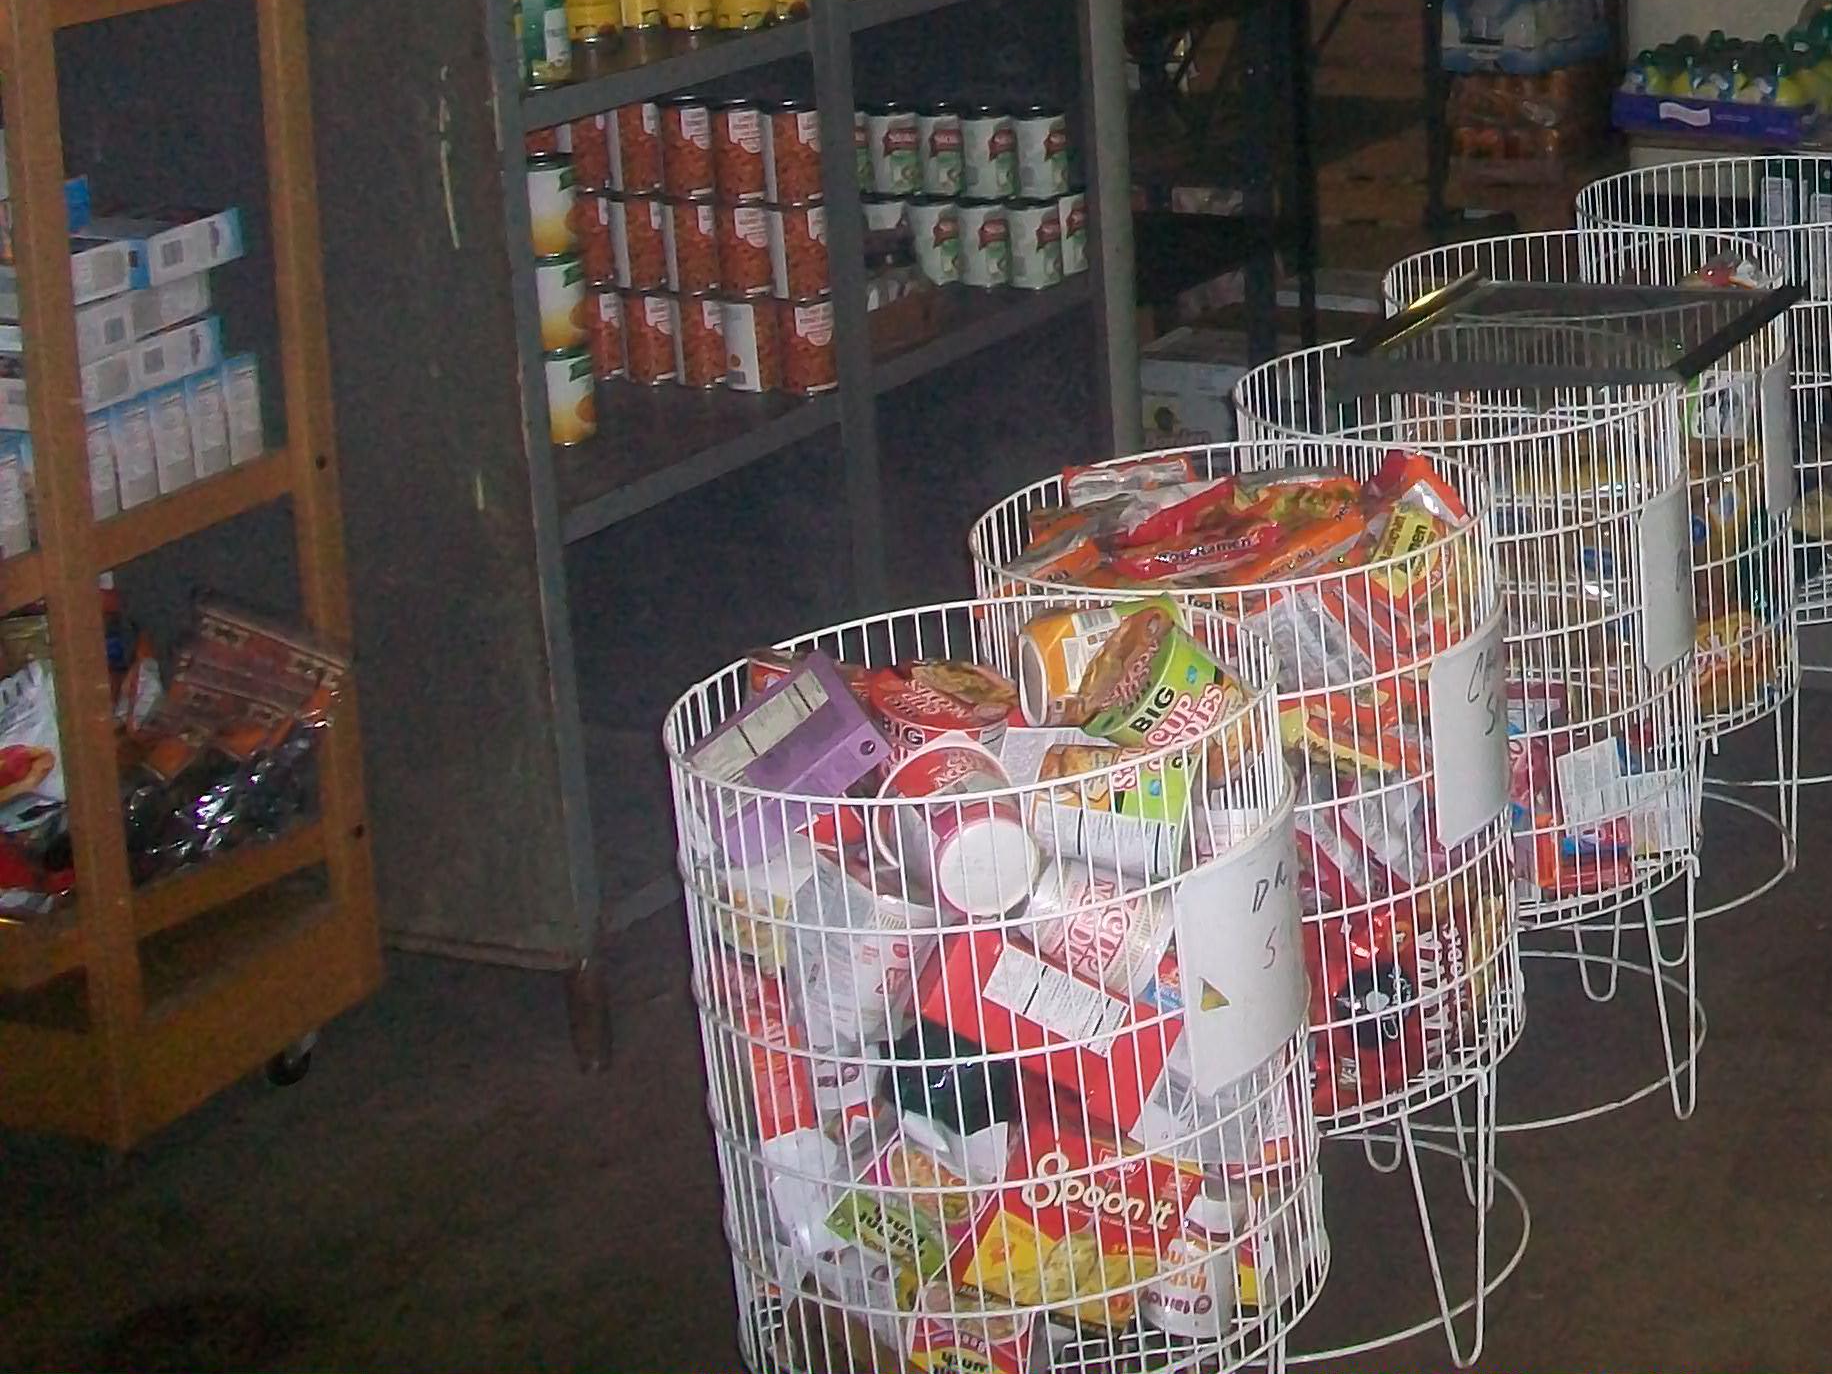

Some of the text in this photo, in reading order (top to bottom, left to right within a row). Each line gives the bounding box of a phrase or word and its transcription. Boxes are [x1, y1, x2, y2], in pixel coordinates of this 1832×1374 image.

[1128, 685, 1177, 733] BIG
[1145, 693, 1195, 748] CUP
[1021, 1151, 1146, 1222] Spoon
